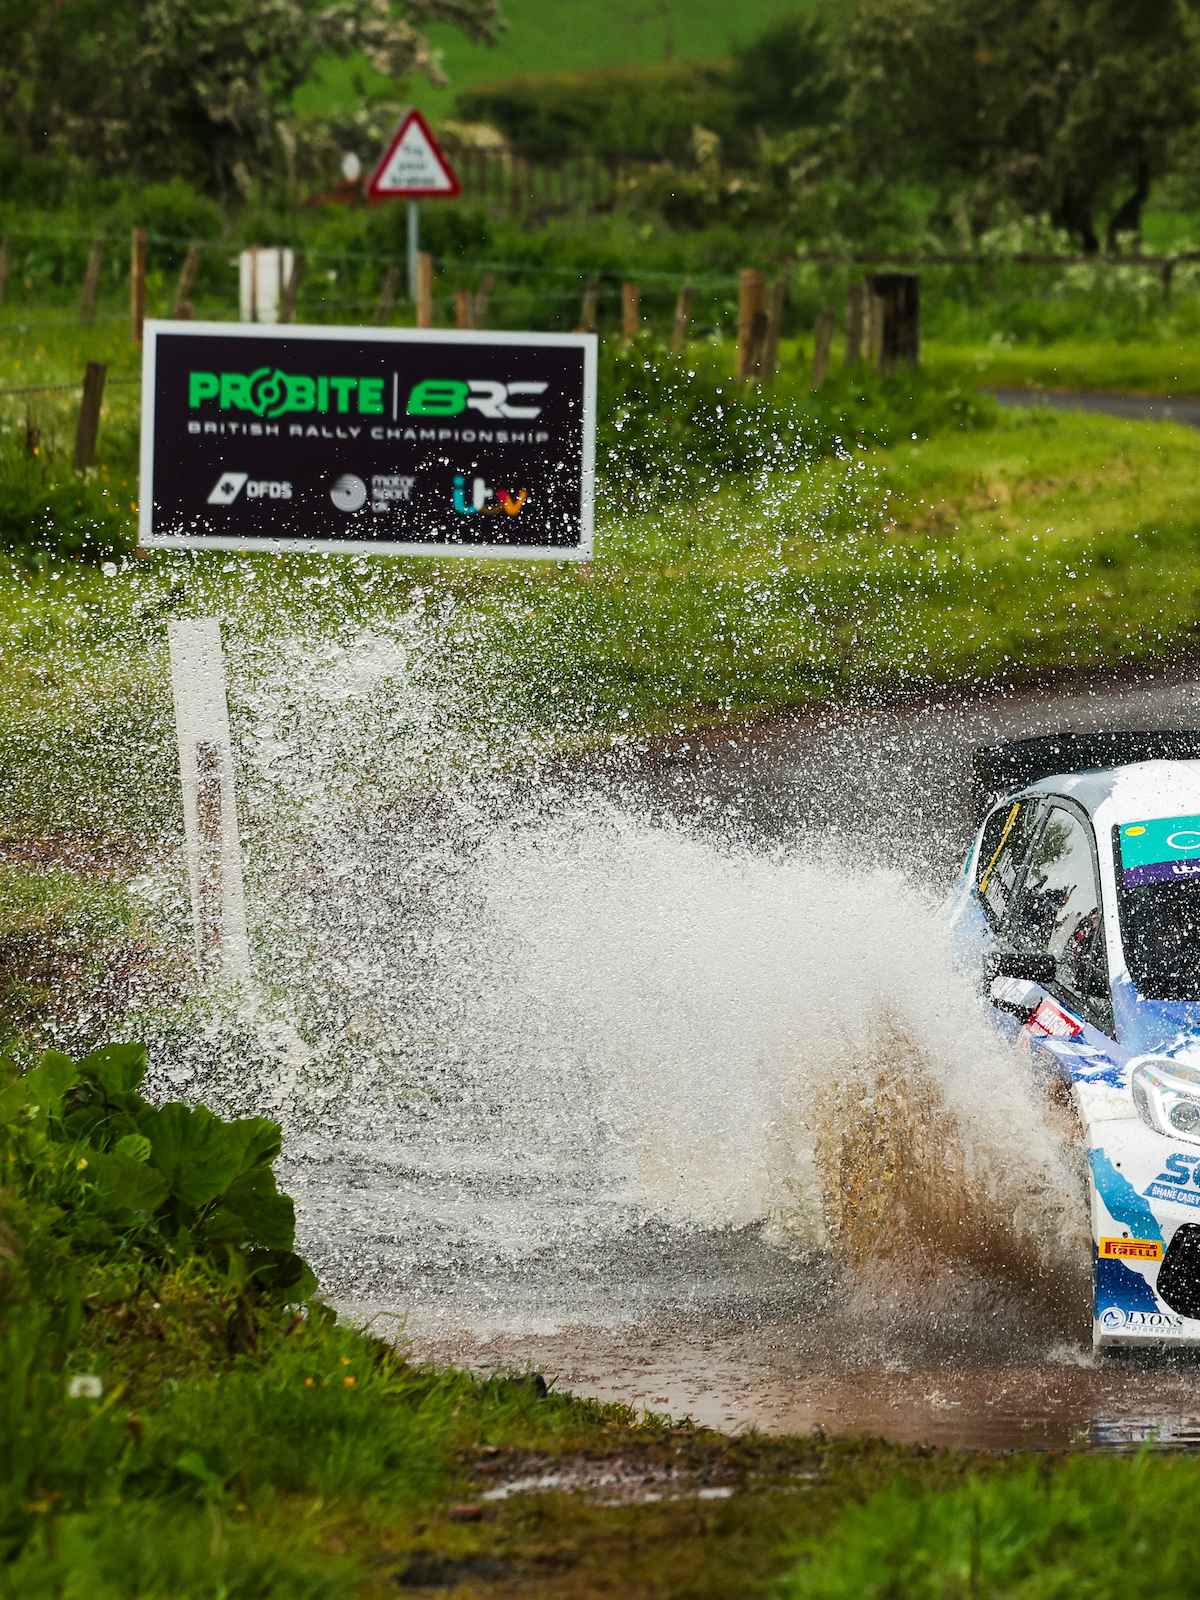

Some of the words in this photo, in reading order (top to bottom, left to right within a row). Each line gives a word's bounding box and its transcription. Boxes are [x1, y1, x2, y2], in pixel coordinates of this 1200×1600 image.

[189, 367, 385, 418] PROBITE
[406, 379, 549, 420] BRC
[188, 422, 280, 438] BRITISH
[289, 427, 360, 440] RALLY
[371, 428, 550, 444] CHAMPIONSHIP
[247, 482, 292, 499] DFDS
[453, 476, 528, 516] itv
[1152, 1186, 1177, 1200] SHANE
[1177, 1191, 1200, 1205] CASEY
[1105, 1242, 1158, 1257] PIRELLI
[1129, 1312, 1183, 1328] LYONS
